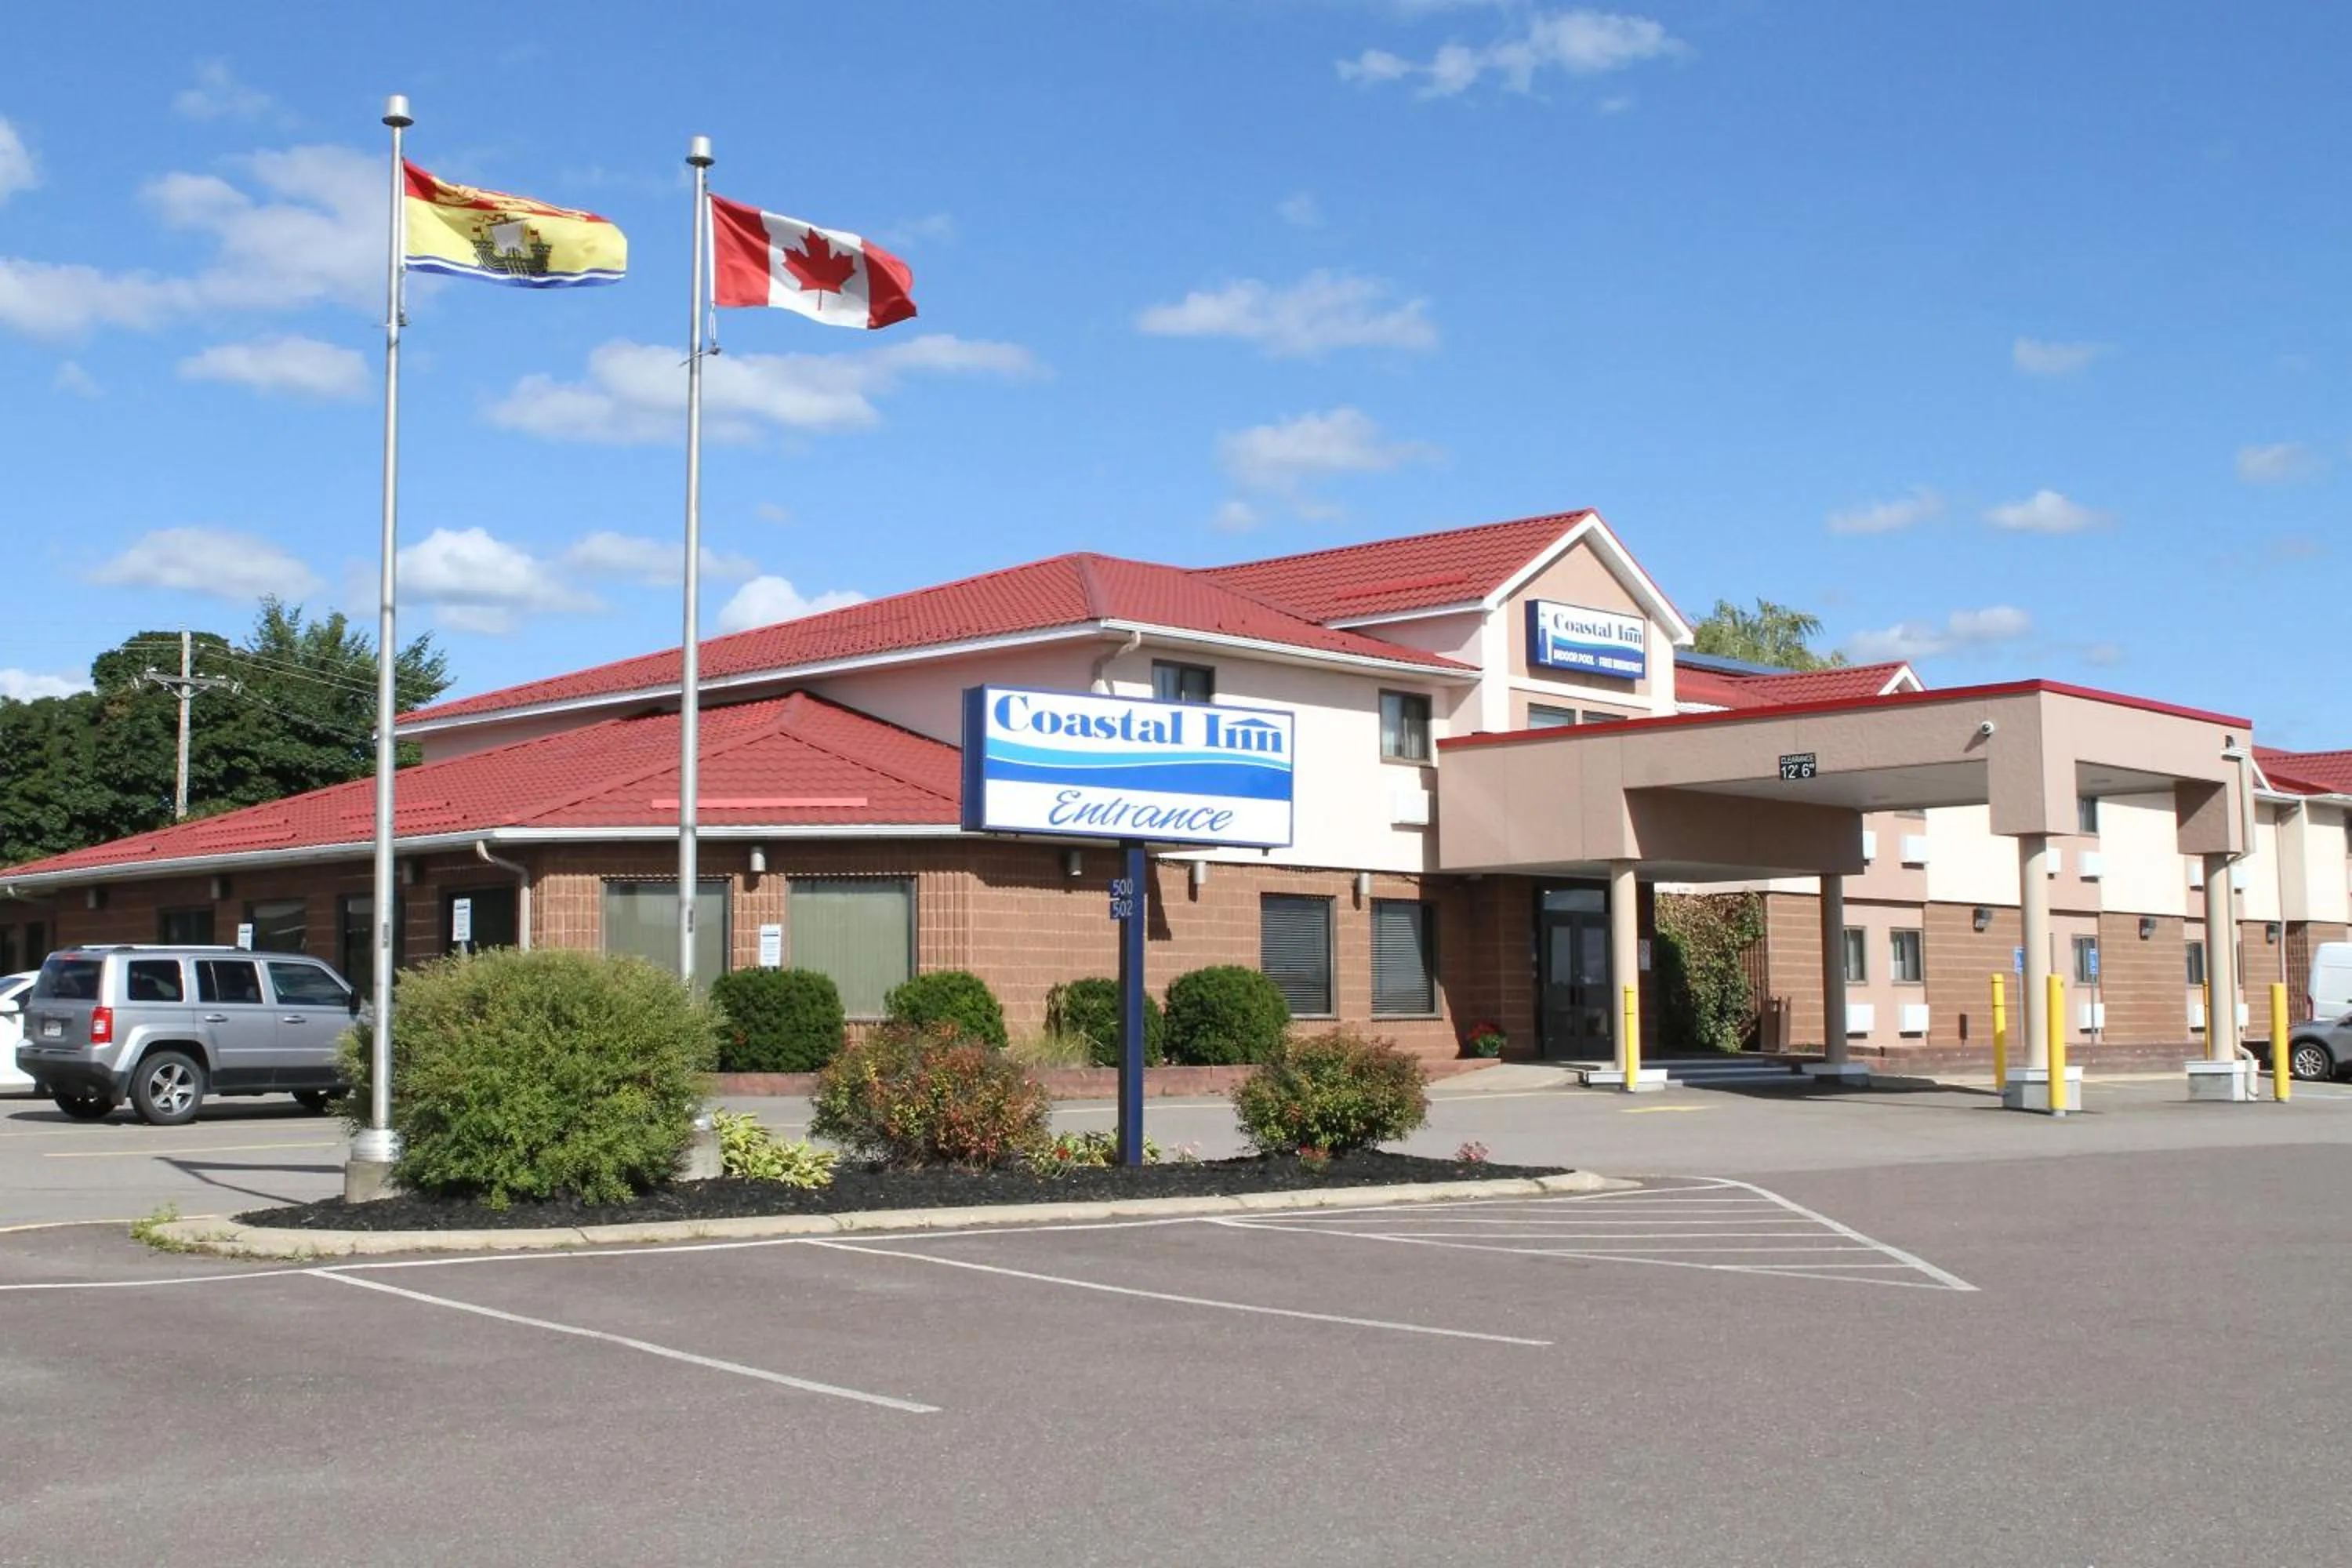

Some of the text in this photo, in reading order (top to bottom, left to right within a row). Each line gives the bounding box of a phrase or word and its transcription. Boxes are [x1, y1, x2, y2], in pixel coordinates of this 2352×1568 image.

[1553, 613, 1642, 644] Coastal Inn
[994, 694, 1283, 753] Coastal Inn
[1048, 789, 1234, 832] Entrance
[1113, 878, 1134, 895] 500
[1113, 900, 1134, 917] 502
